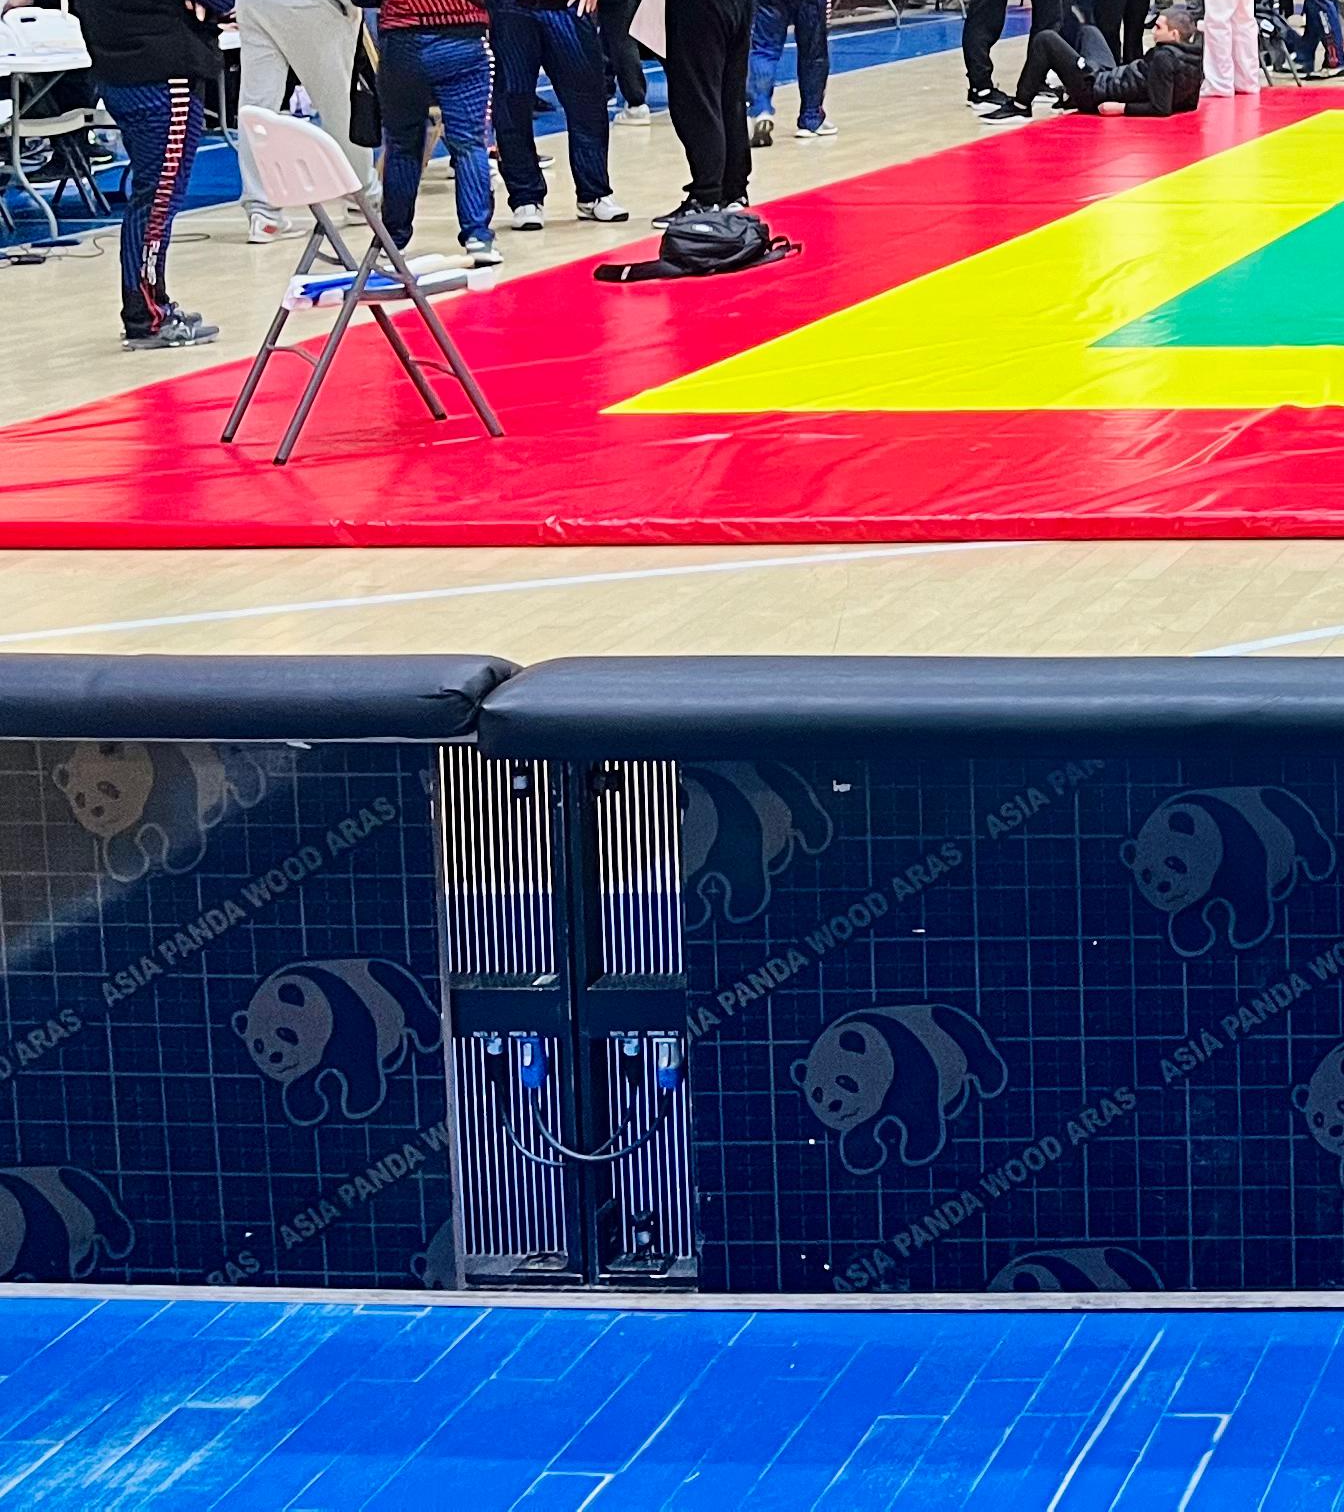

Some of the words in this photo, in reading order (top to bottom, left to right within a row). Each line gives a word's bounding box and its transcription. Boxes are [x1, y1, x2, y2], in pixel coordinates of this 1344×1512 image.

[986, 785, 1050, 839] ASIA
[102, 955, 164, 1008] ASIA
[157, 898, 245, 964] PANDA
[241, 844, 323, 909] WOOD
[326, 796, 398, 855] ARAS
[717, 947, 810, 1016] PANDA
[805, 891, 889, 955] WOOD
[890, 842, 964, 902] ARAS
[16, 1008, 83, 1066] ARAS
[1160, 1028, 1224, 1085] ASIA
[1221, 974, 1312, 1041] PANDA
[279, 1198, 341, 1250] ASIA
[337, 1143, 426, 1209] PANDA
[894, 1190, 983, 1258] PANDA
[980, 1136, 1063, 1198] WOOD
[1065, 1087, 1137, 1146] ARAS
